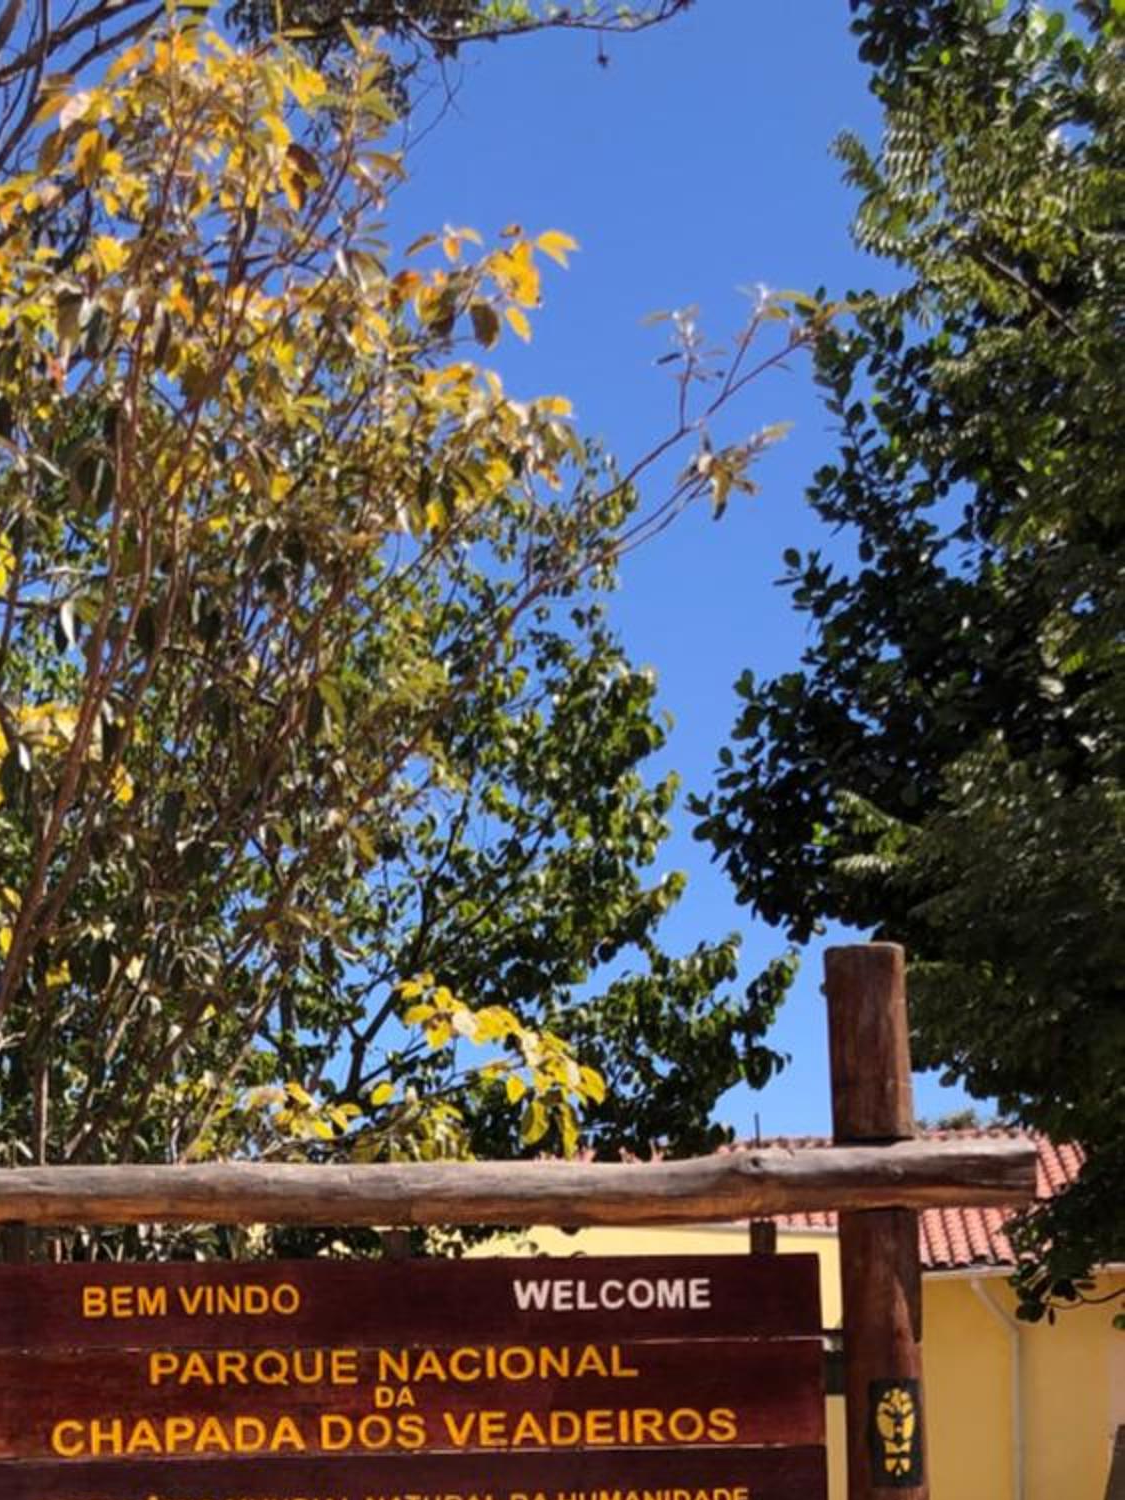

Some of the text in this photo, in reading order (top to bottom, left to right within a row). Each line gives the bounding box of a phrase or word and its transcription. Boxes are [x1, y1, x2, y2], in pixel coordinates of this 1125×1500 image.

[82, 1283, 300, 1318] BEM VINDO
[513, 1278, 711, 1311] WELCOME
[149, 1345, 639, 1386] PARQUE NACIONAL
[374, 1386, 416, 1408] DA
[50, 1407, 738, 1457] CHAPADA DOS VEADEIROS
